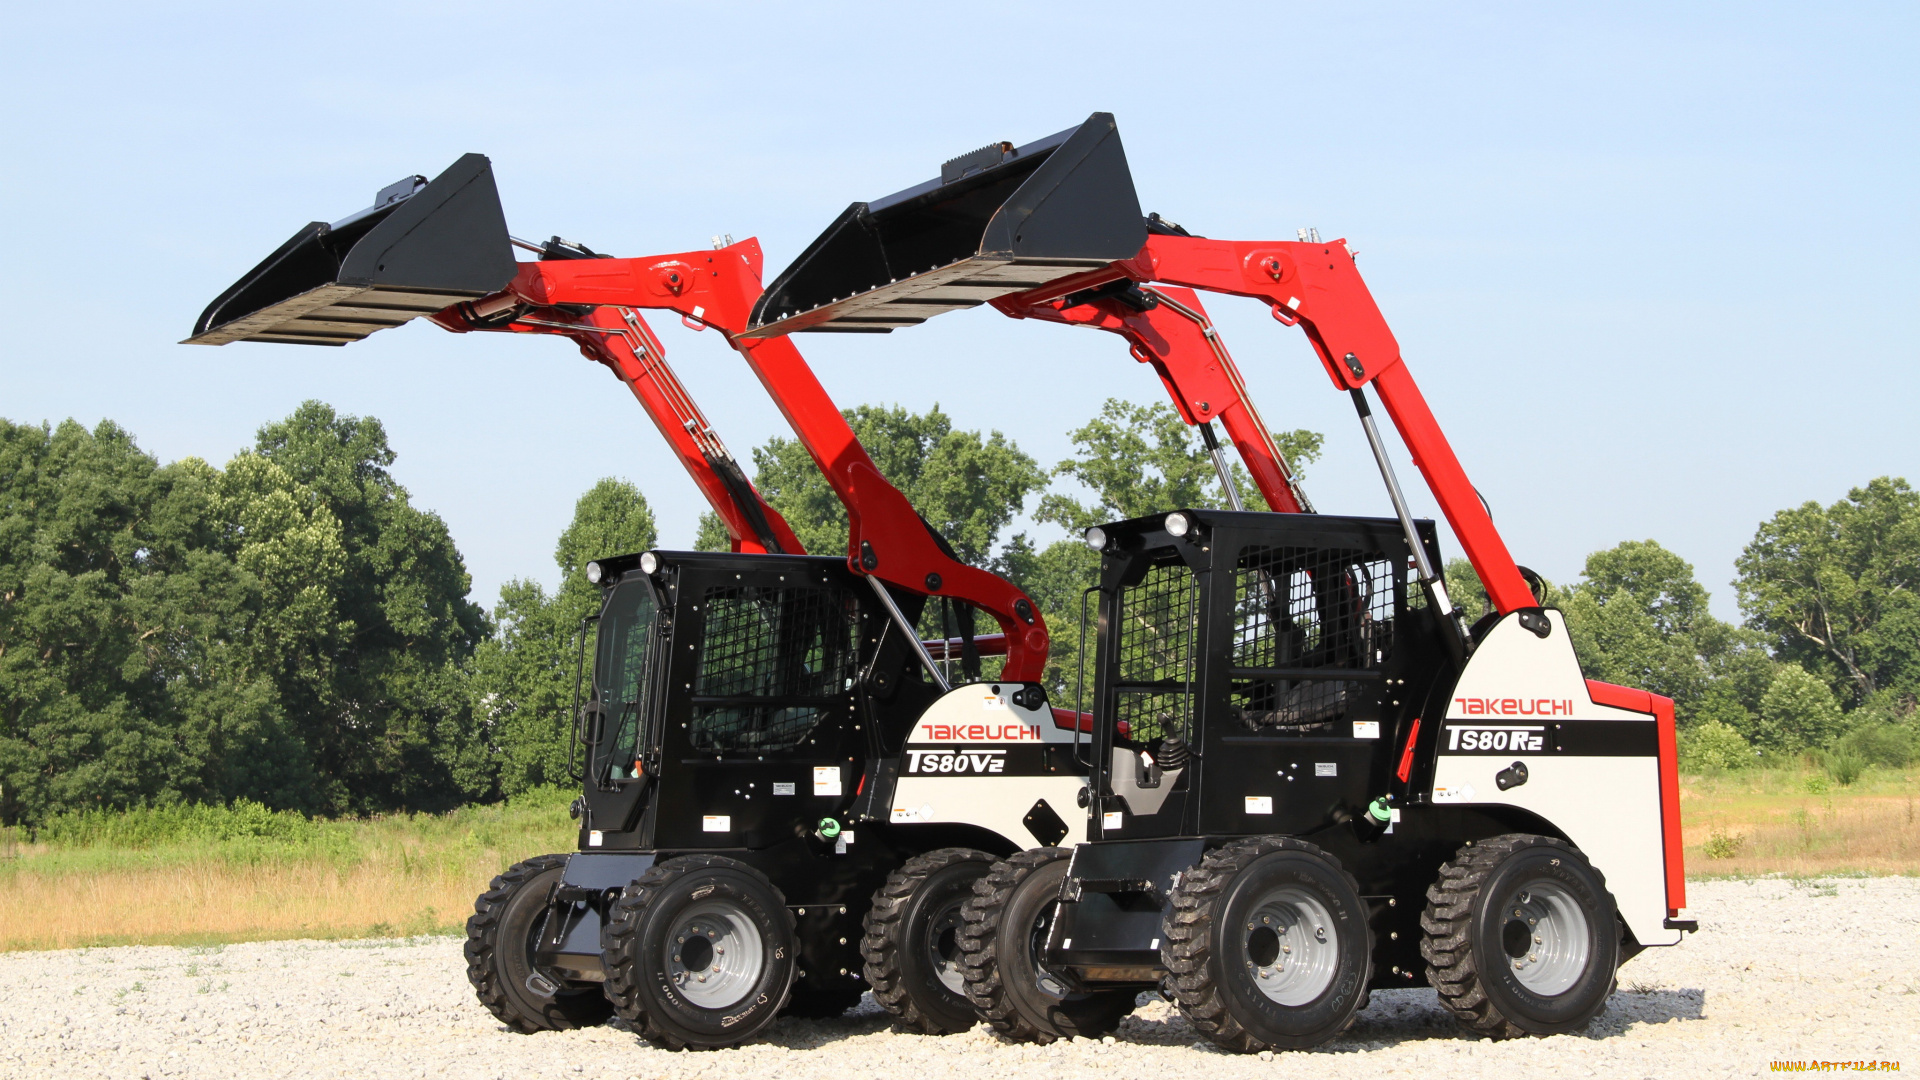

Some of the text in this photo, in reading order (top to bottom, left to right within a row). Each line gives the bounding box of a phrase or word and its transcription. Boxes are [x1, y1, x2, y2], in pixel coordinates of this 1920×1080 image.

[1455, 698, 1573, 715] TAKEUCHI
[922, 725, 1041, 740] TAKEUCHI
[1445, 725, 1545, 750] TS80R2
[906, 749, 1007, 773] TS80V2
